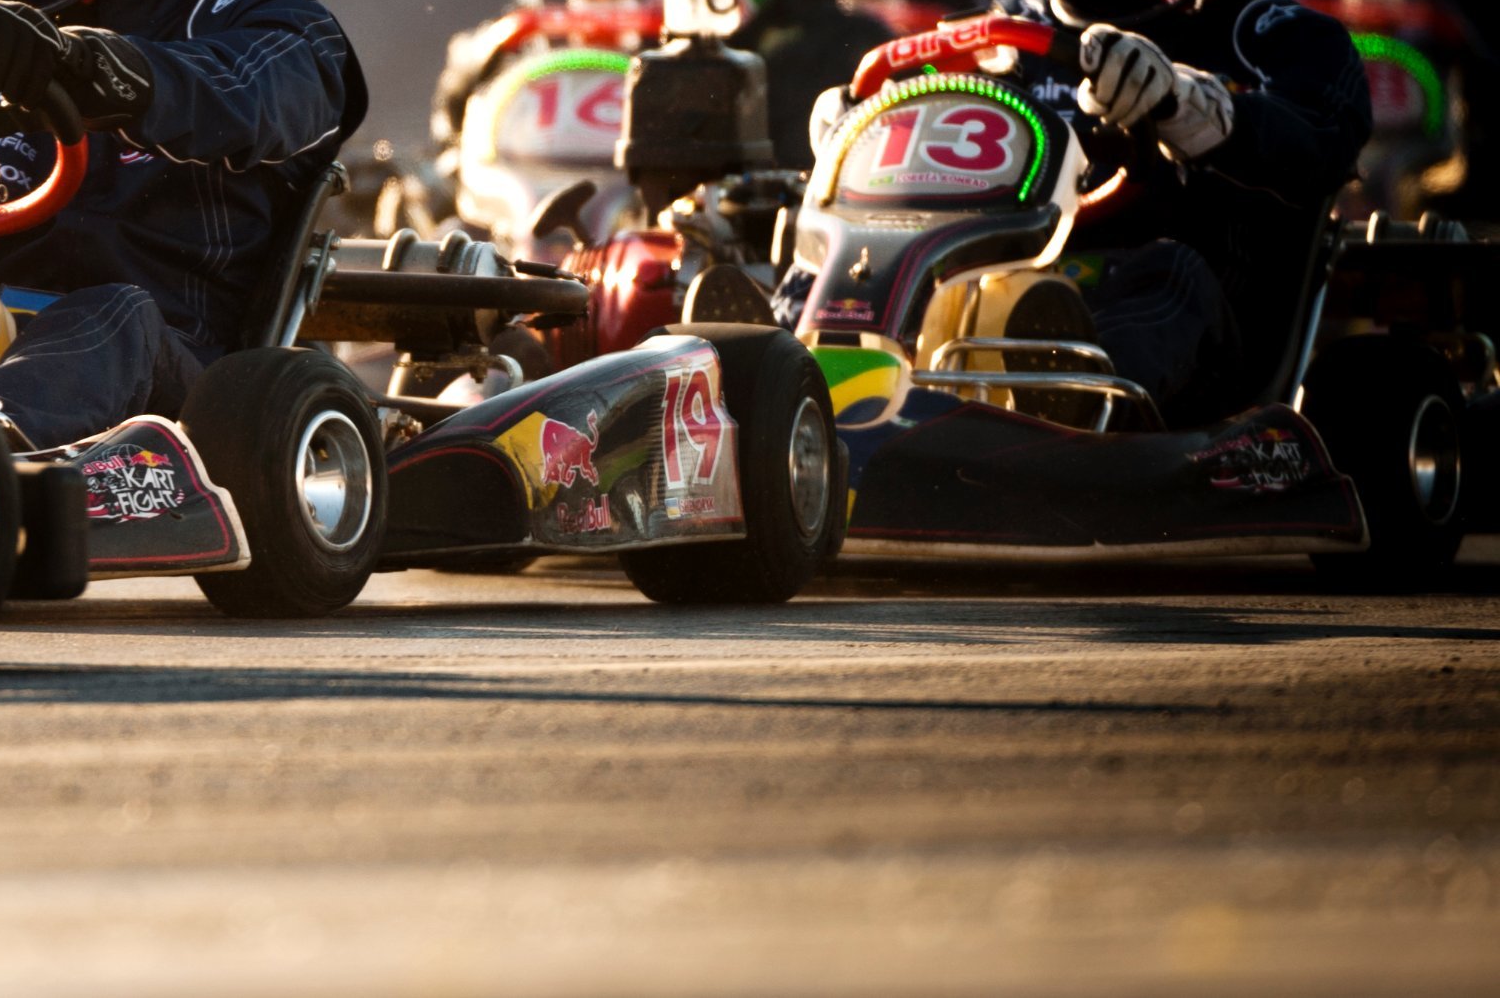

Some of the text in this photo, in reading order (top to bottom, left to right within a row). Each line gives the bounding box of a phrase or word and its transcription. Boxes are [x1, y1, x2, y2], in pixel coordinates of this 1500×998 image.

[874, 104, 1016, 173] 13
[661, 370, 723, 490] 19
[121, 467, 175, 490] KART
[116, 490, 178, 515] FIGHT
